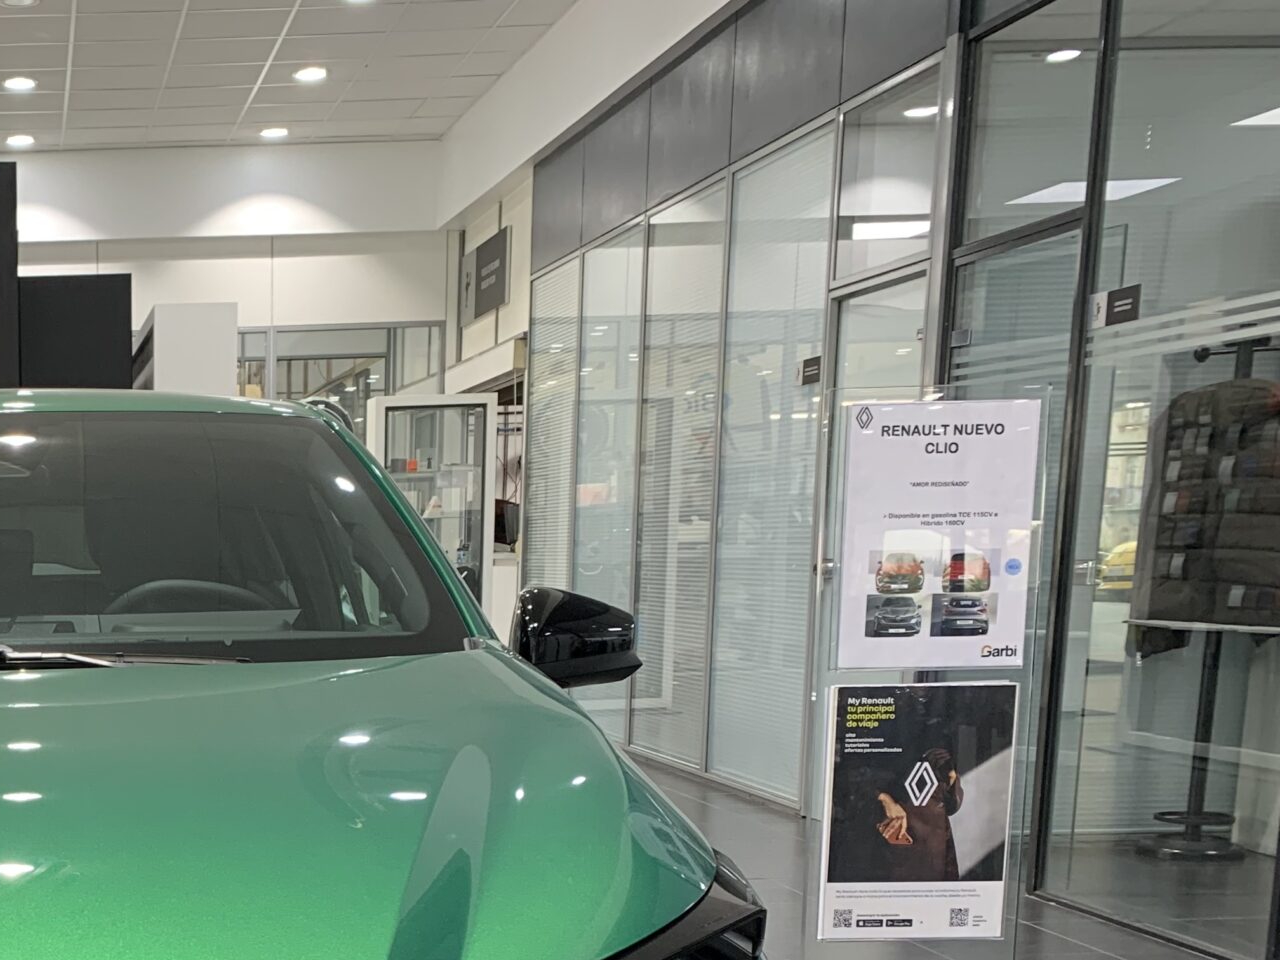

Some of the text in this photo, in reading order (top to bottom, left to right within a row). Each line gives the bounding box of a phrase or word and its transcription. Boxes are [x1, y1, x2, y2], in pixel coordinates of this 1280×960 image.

[881, 423, 1005, 437] RENAULT NUEVO
[924, 442, 960, 454] CLIO
[888, 512, 920, 520] Disponible
[981, 645, 1017, 657] Garbi
[847, 697, 860, 705] My
[857, 705, 895, 713] principal
[846, 712, 895, 720] compañero
[858, 721, 879, 729] viaje
